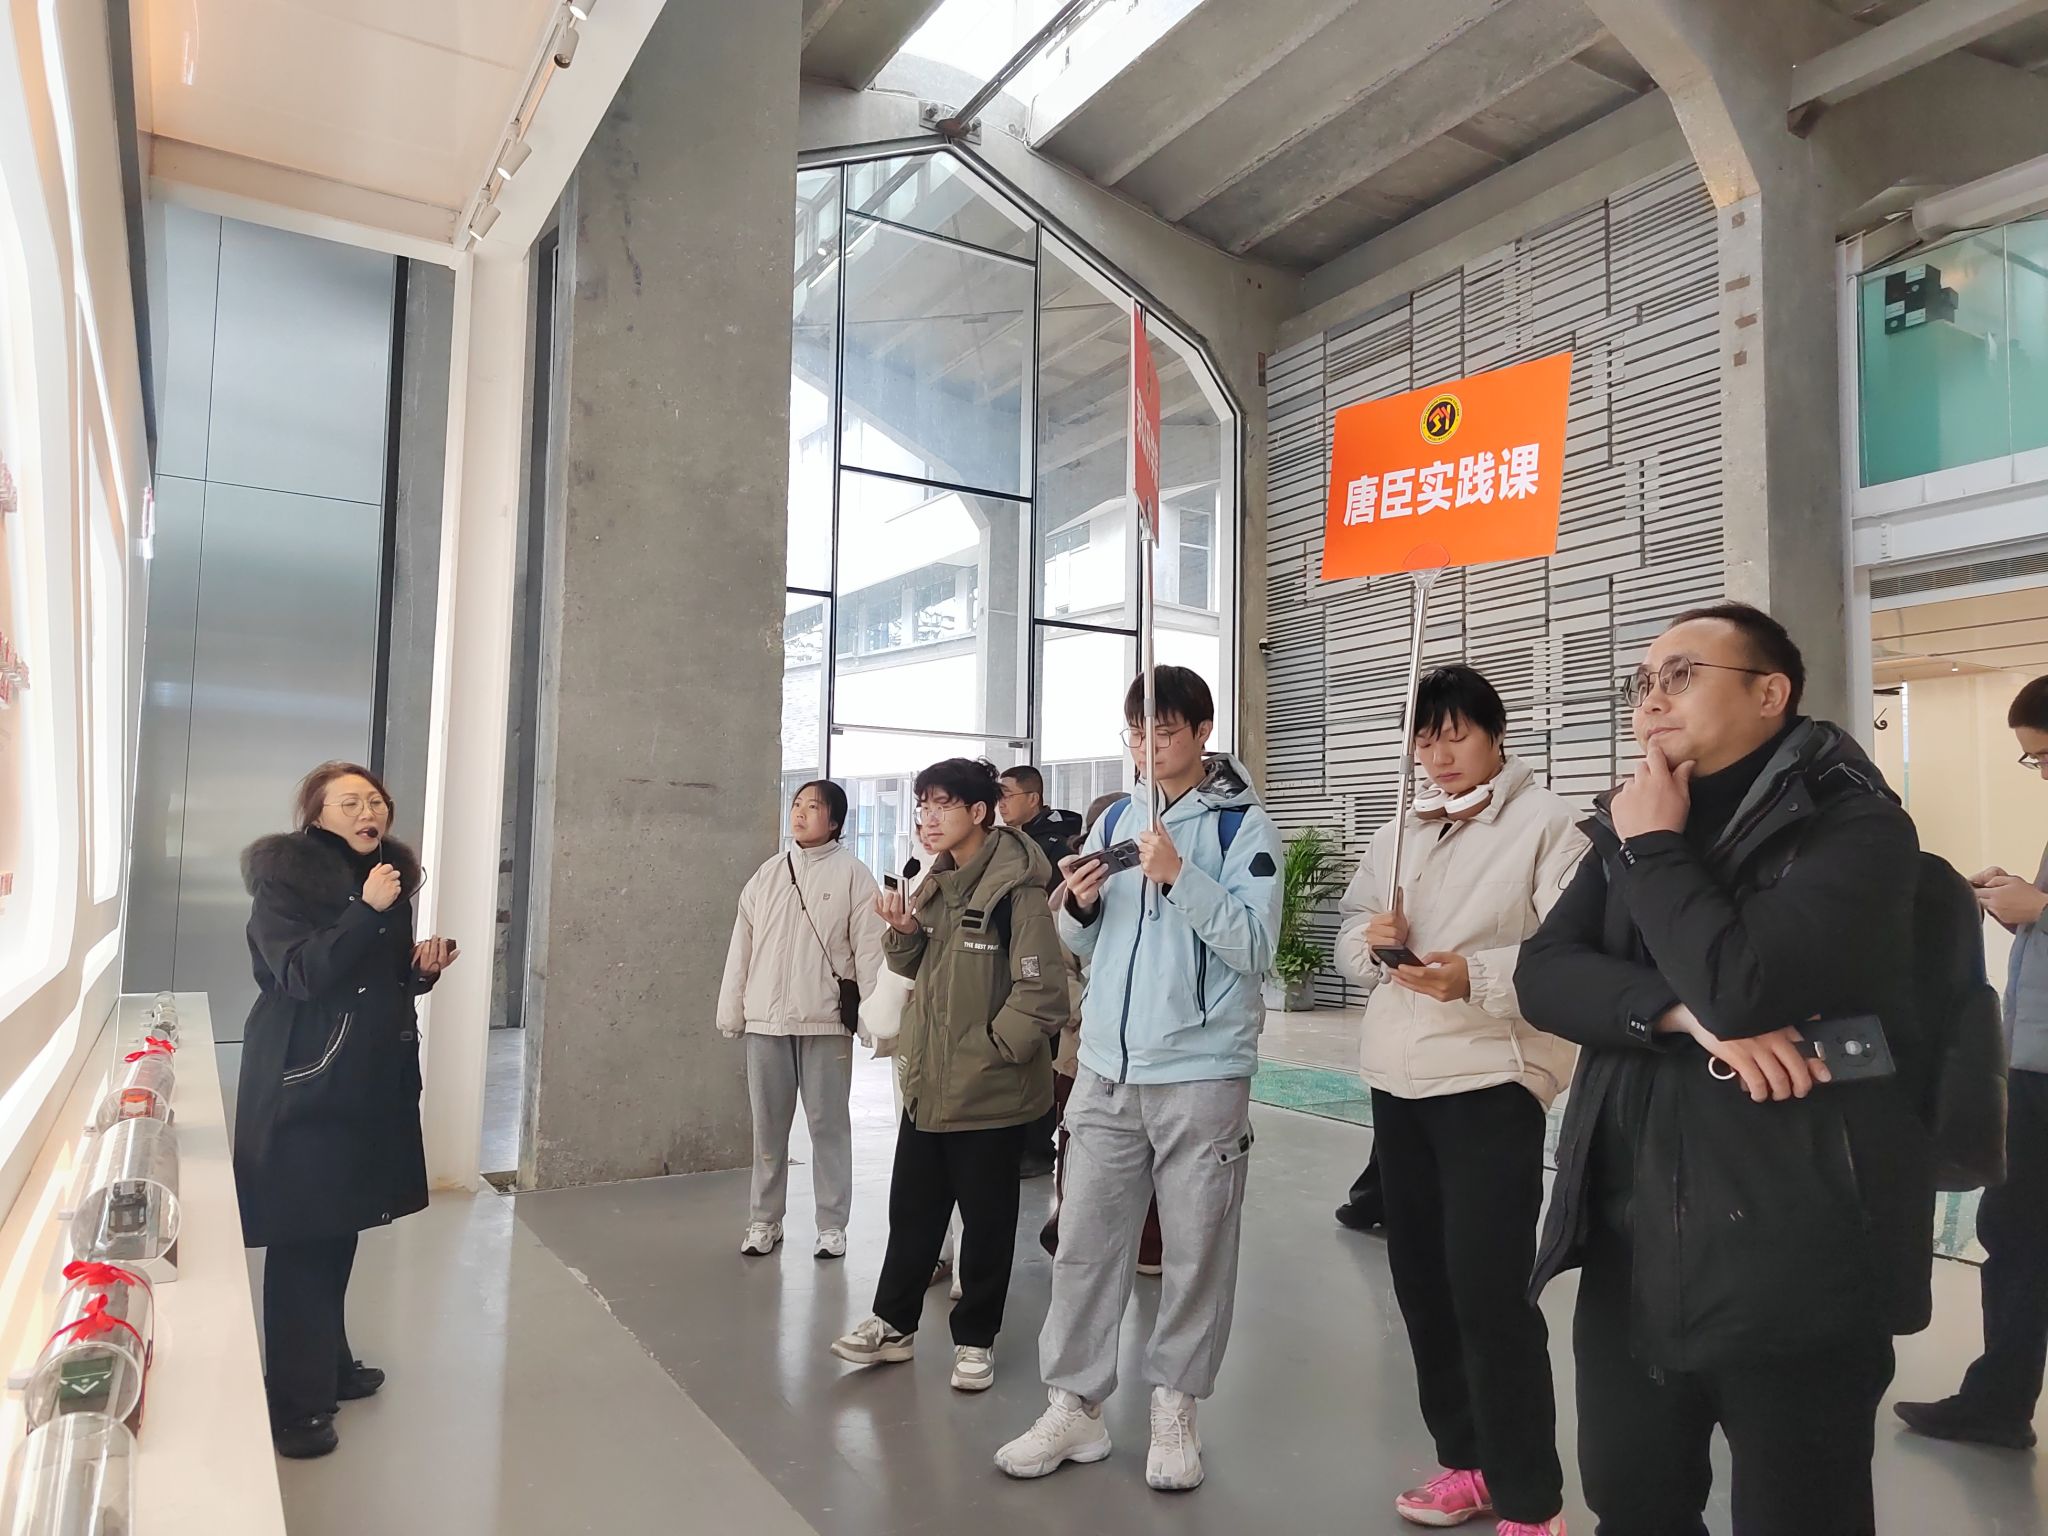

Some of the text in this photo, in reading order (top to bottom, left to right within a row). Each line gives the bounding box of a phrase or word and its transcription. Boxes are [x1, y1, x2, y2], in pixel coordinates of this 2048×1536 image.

[1343, 443, 1540, 526] 唐臣实践课
